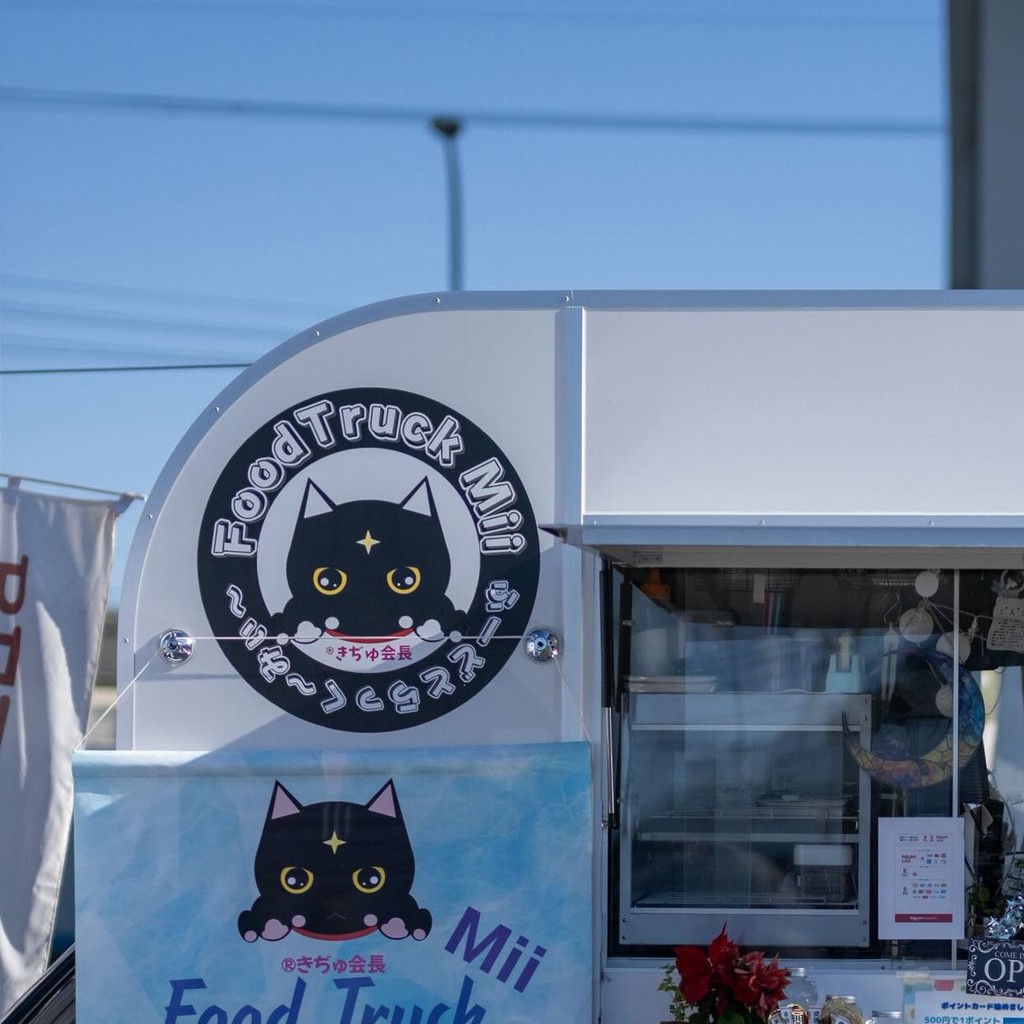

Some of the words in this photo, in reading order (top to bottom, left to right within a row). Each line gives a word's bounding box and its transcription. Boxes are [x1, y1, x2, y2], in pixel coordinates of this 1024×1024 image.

[212, 400, 464, 558] FoodTruck
[459, 457, 527, 555] Mii
[444, 906, 547, 993] Mii
[994, 951, 1017, 959] COME
[924, 1016, 1000, 1024] 500円で1ポイント
